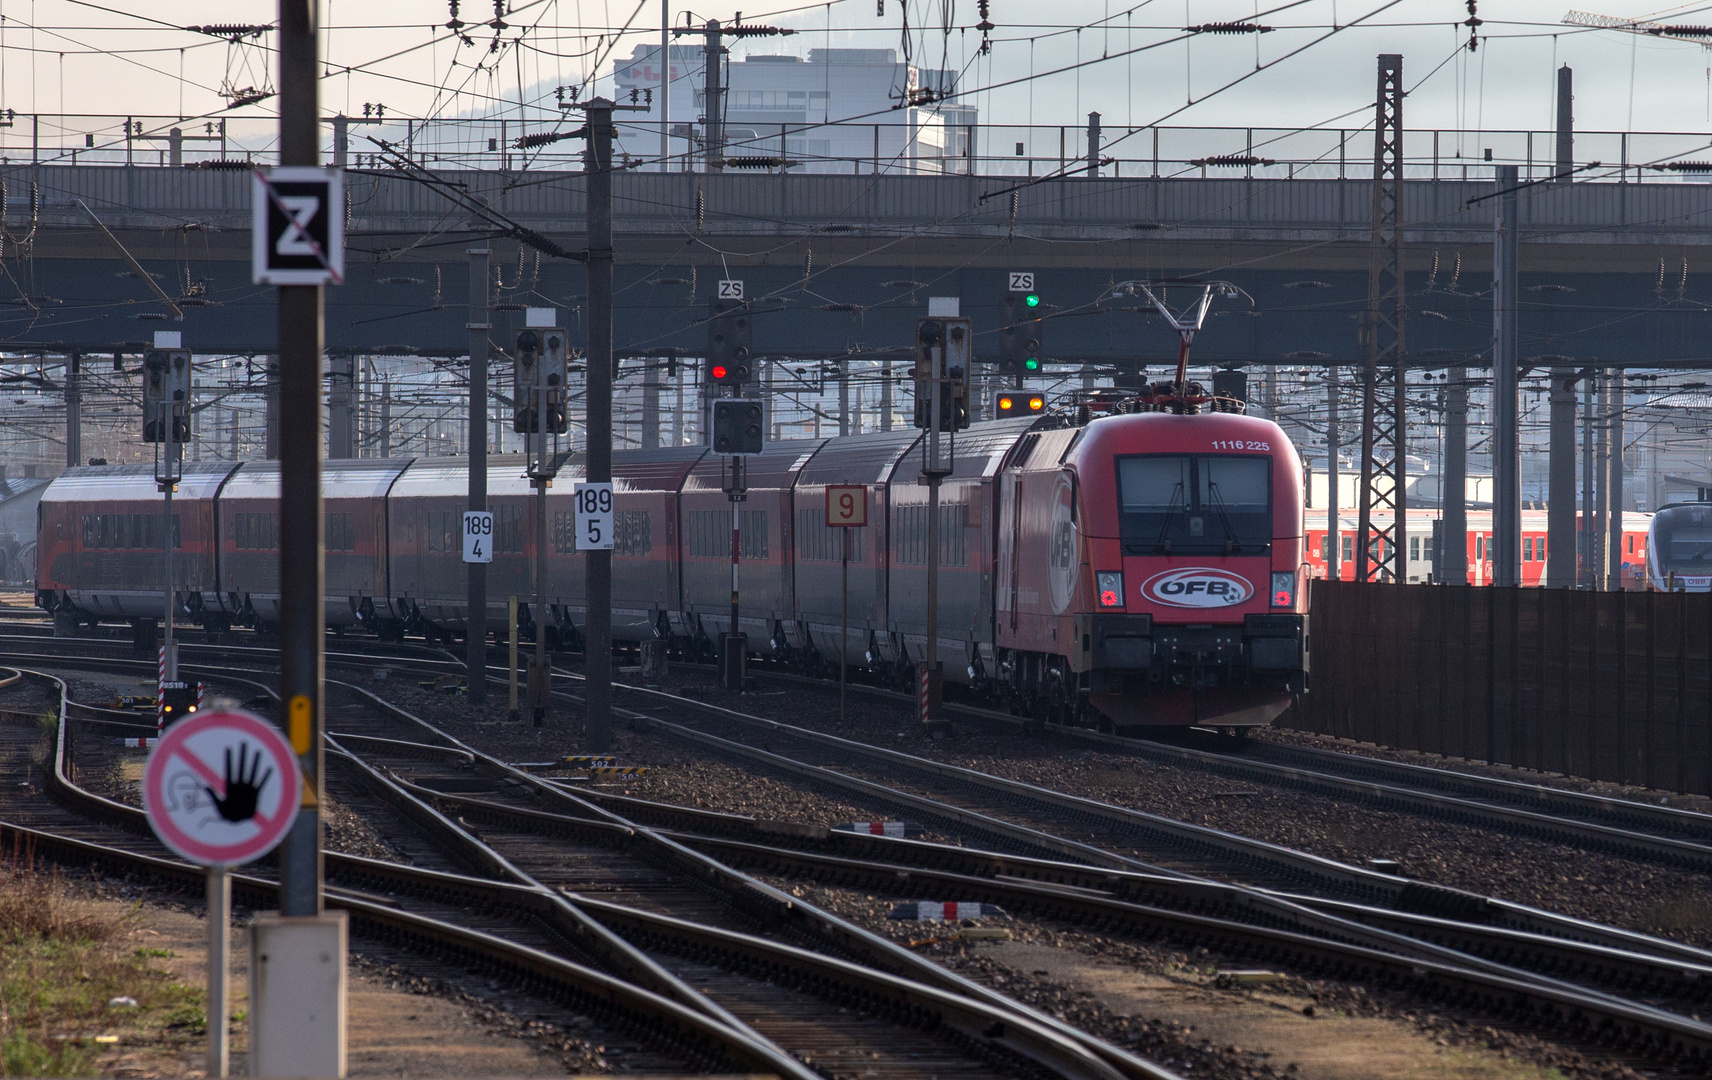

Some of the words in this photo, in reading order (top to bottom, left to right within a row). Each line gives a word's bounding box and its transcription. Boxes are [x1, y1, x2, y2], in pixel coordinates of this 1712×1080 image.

[276, 196, 320, 255] Z
[720, 283, 742, 296] ZS
[1011, 275, 1032, 288] ZS
[1212, 440, 1244, 450] 1116
[1246, 441, 1270, 451] 225
[575, 488, 612, 513] 189
[839, 493, 854, 519] 9
[465, 516, 492, 535] 189
[588, 519, 601, 543] 5
[472, 539, 482, 558] 4
[591, 760, 609, 768] 502
